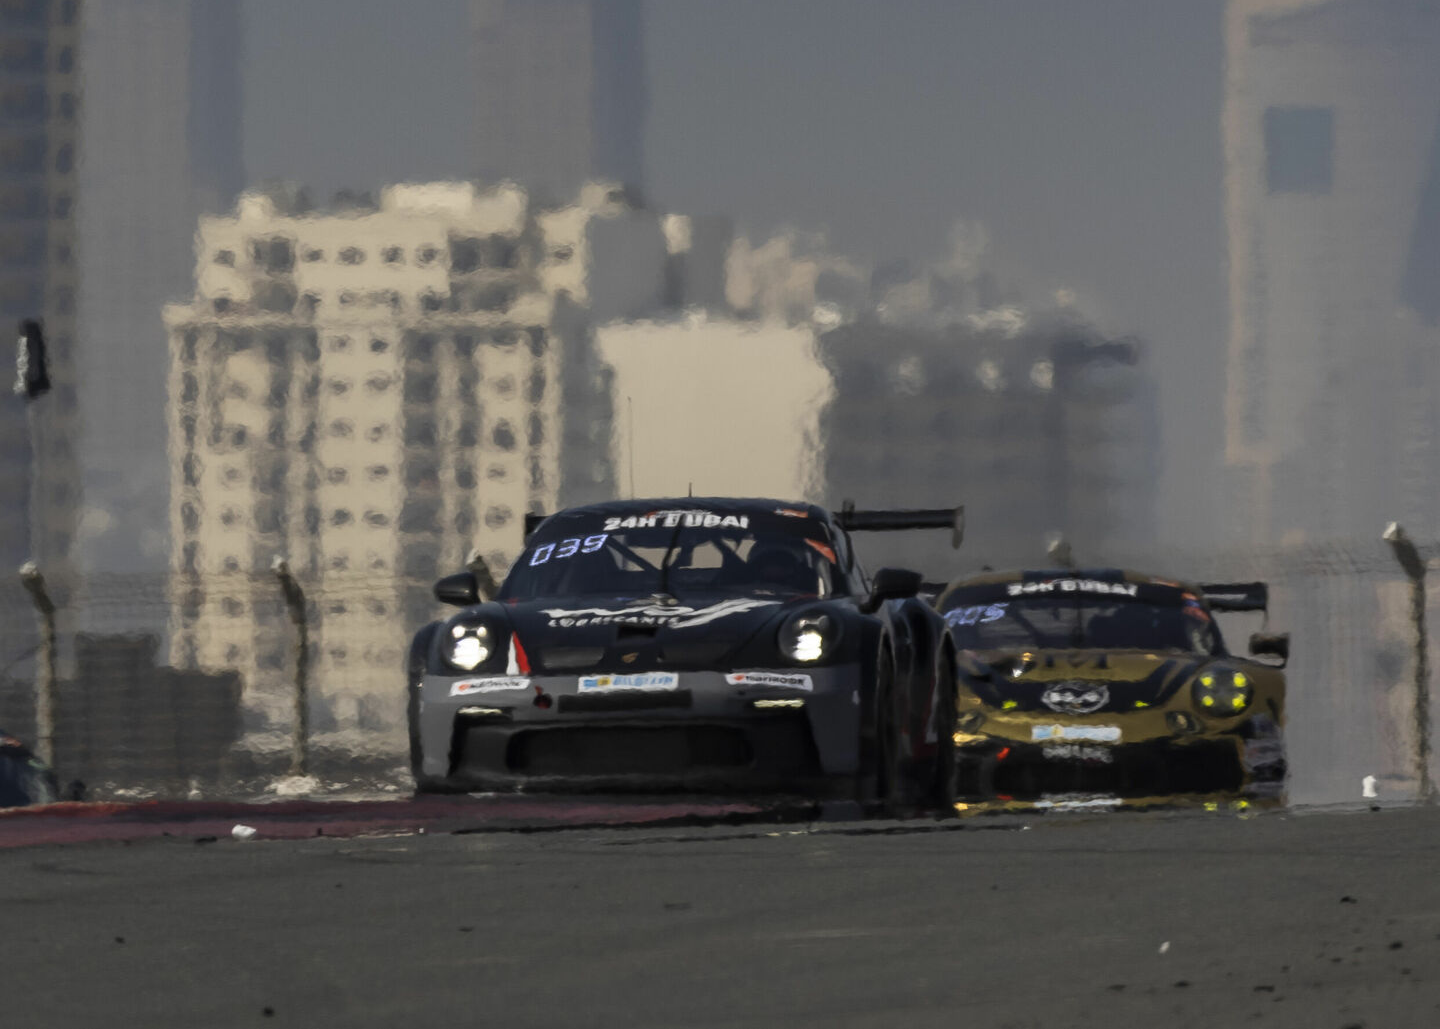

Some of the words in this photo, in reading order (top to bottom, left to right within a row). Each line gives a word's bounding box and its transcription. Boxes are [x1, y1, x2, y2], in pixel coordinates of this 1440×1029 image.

[603, 513, 656, 532] 24H
[662, 512, 749, 529] DUBAI
[529, 533, 609, 567] 039
